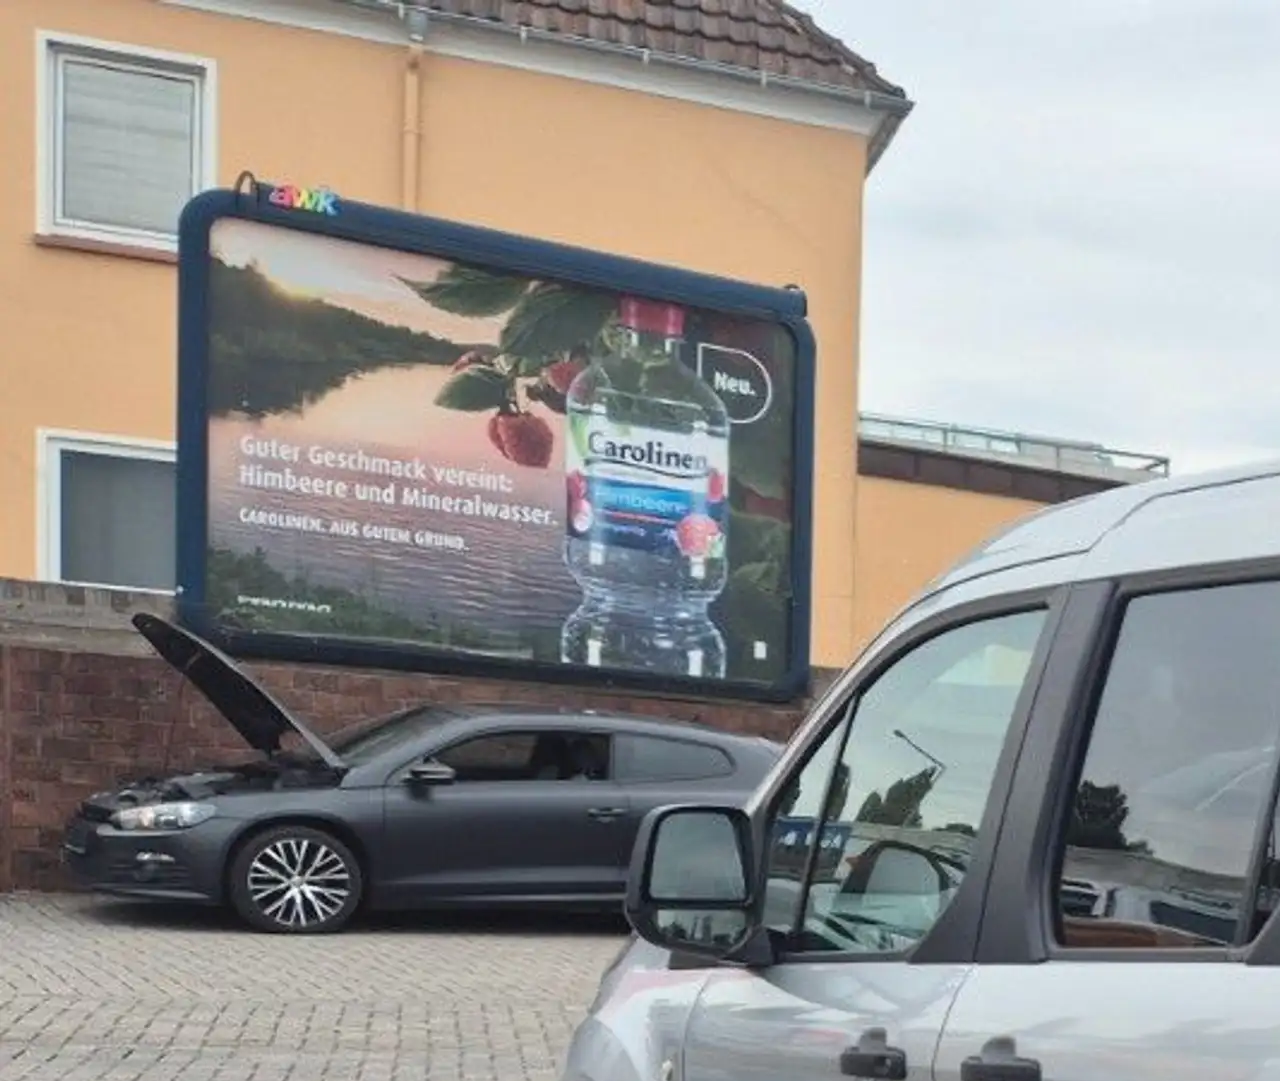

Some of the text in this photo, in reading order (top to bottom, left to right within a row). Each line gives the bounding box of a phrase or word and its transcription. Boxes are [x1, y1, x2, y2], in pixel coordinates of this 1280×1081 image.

[714, 371, 757, 396] Neu.
[239, 435, 513, 493] Guter Geschmack vereint:
[239, 464, 559, 526] Himbeere und Mineralwasser.
[330, 521, 359, 536] AUS
